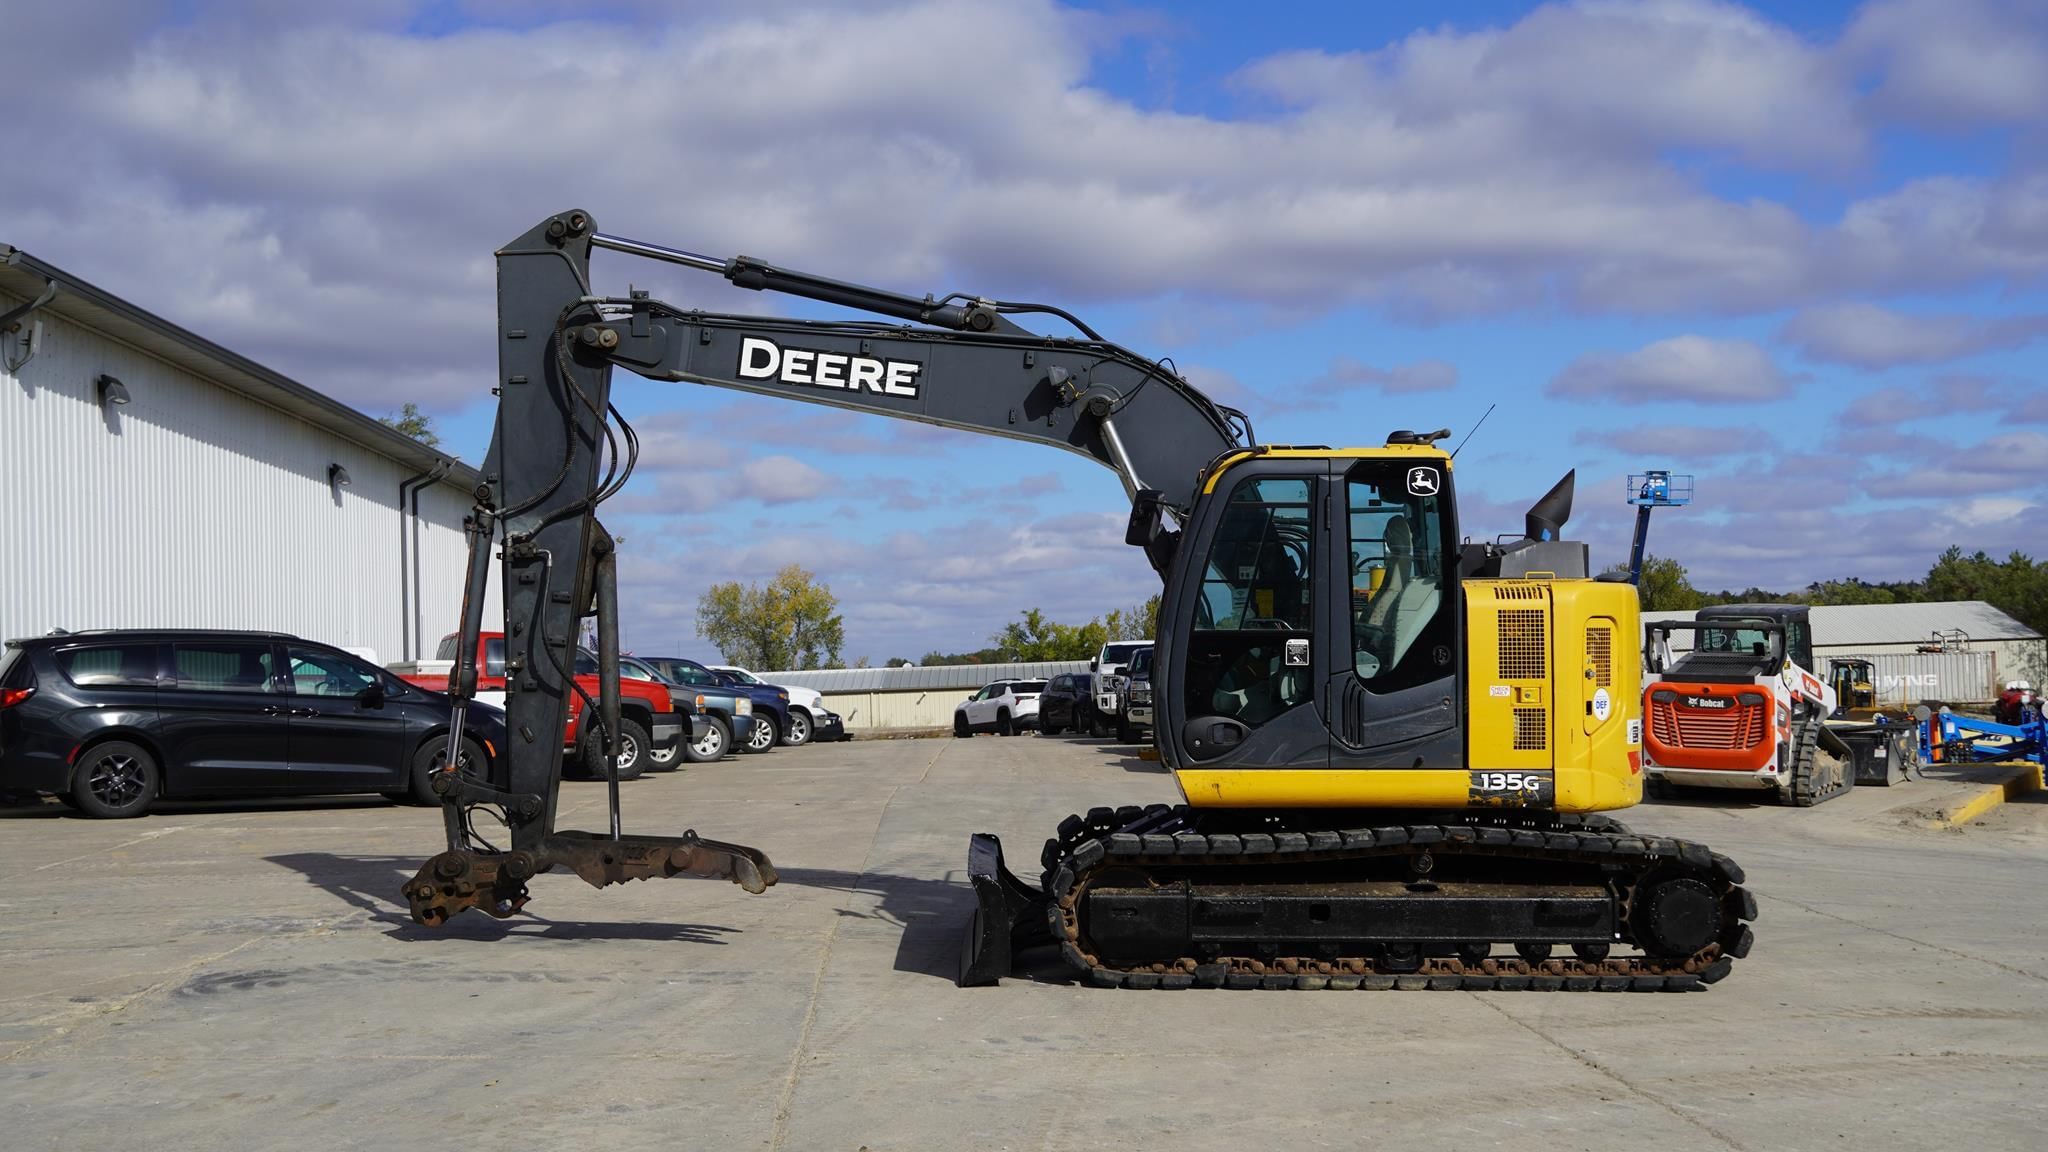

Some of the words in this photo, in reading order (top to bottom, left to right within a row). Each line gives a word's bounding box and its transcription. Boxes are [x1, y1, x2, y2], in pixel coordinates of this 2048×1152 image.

[739, 337, 920, 397] DEERE
[1595, 700, 1608, 710] DEF
[1699, 698, 1725, 708] Bobcat
[1480, 773, 1540, 791] 135G
